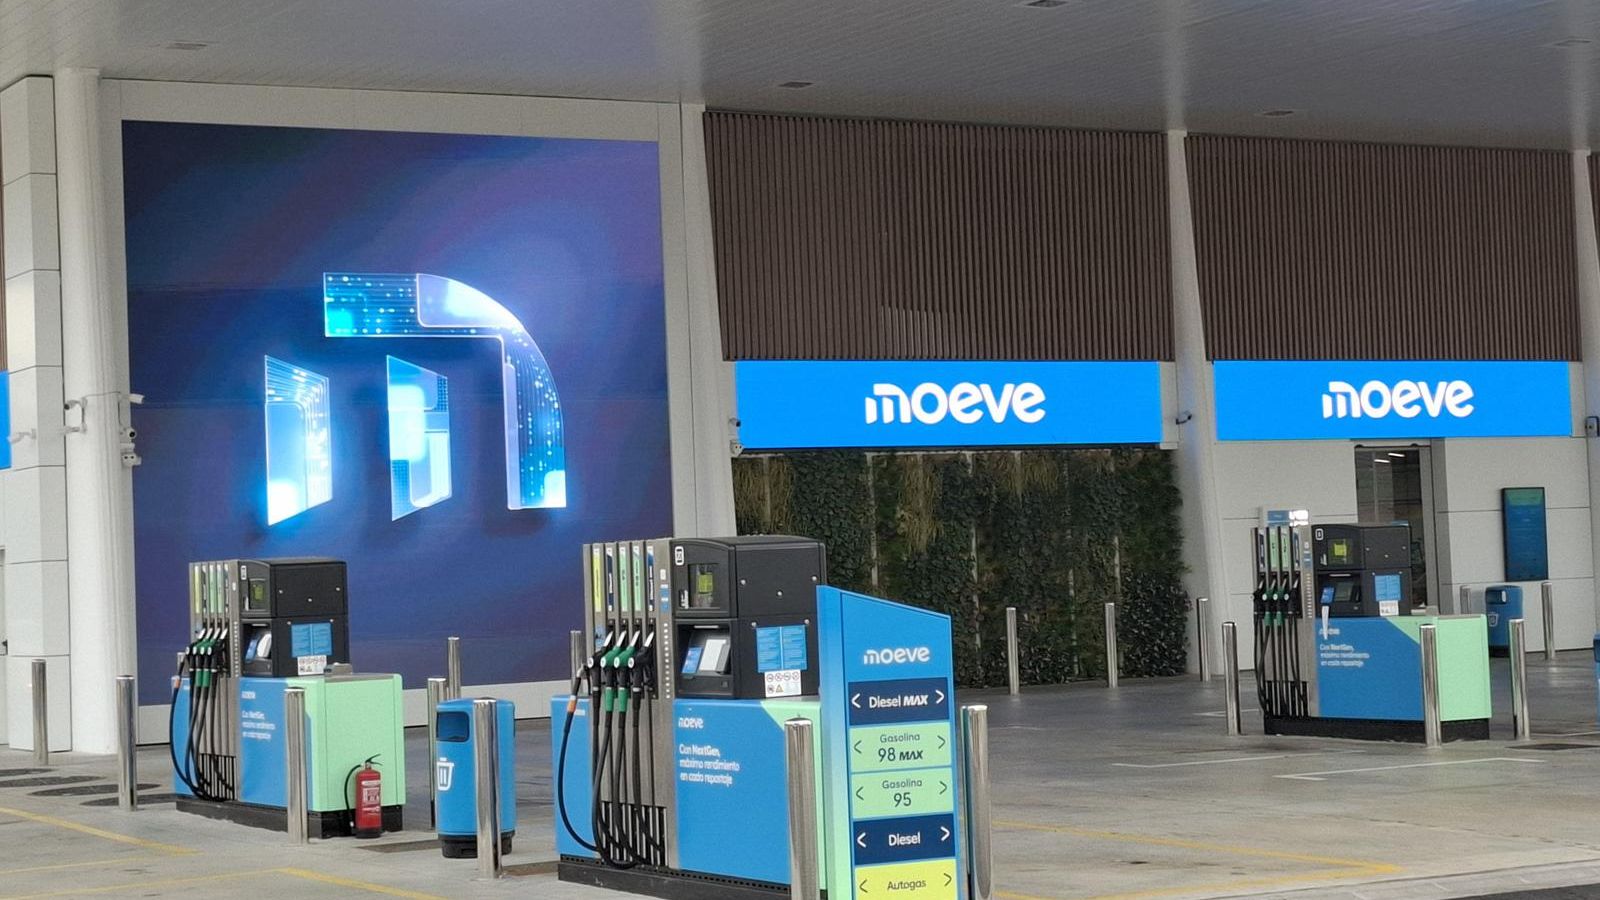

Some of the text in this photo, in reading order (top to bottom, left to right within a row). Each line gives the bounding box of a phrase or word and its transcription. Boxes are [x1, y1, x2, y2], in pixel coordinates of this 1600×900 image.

[864, 381, 1047, 426] moeve
[1321, 379, 1475, 420] moeve
[863, 646, 931, 665] moeve
[868, 694, 929, 709] Diesel MAX
[880, 733, 921, 744] Gasolina
[878, 746, 924, 762] 98 MAX
[882, 779, 922, 789] Gasolina
[893, 791, 912, 808] 95
[888, 831, 921, 847] Diesel
[887, 879, 927, 891] Autogas
